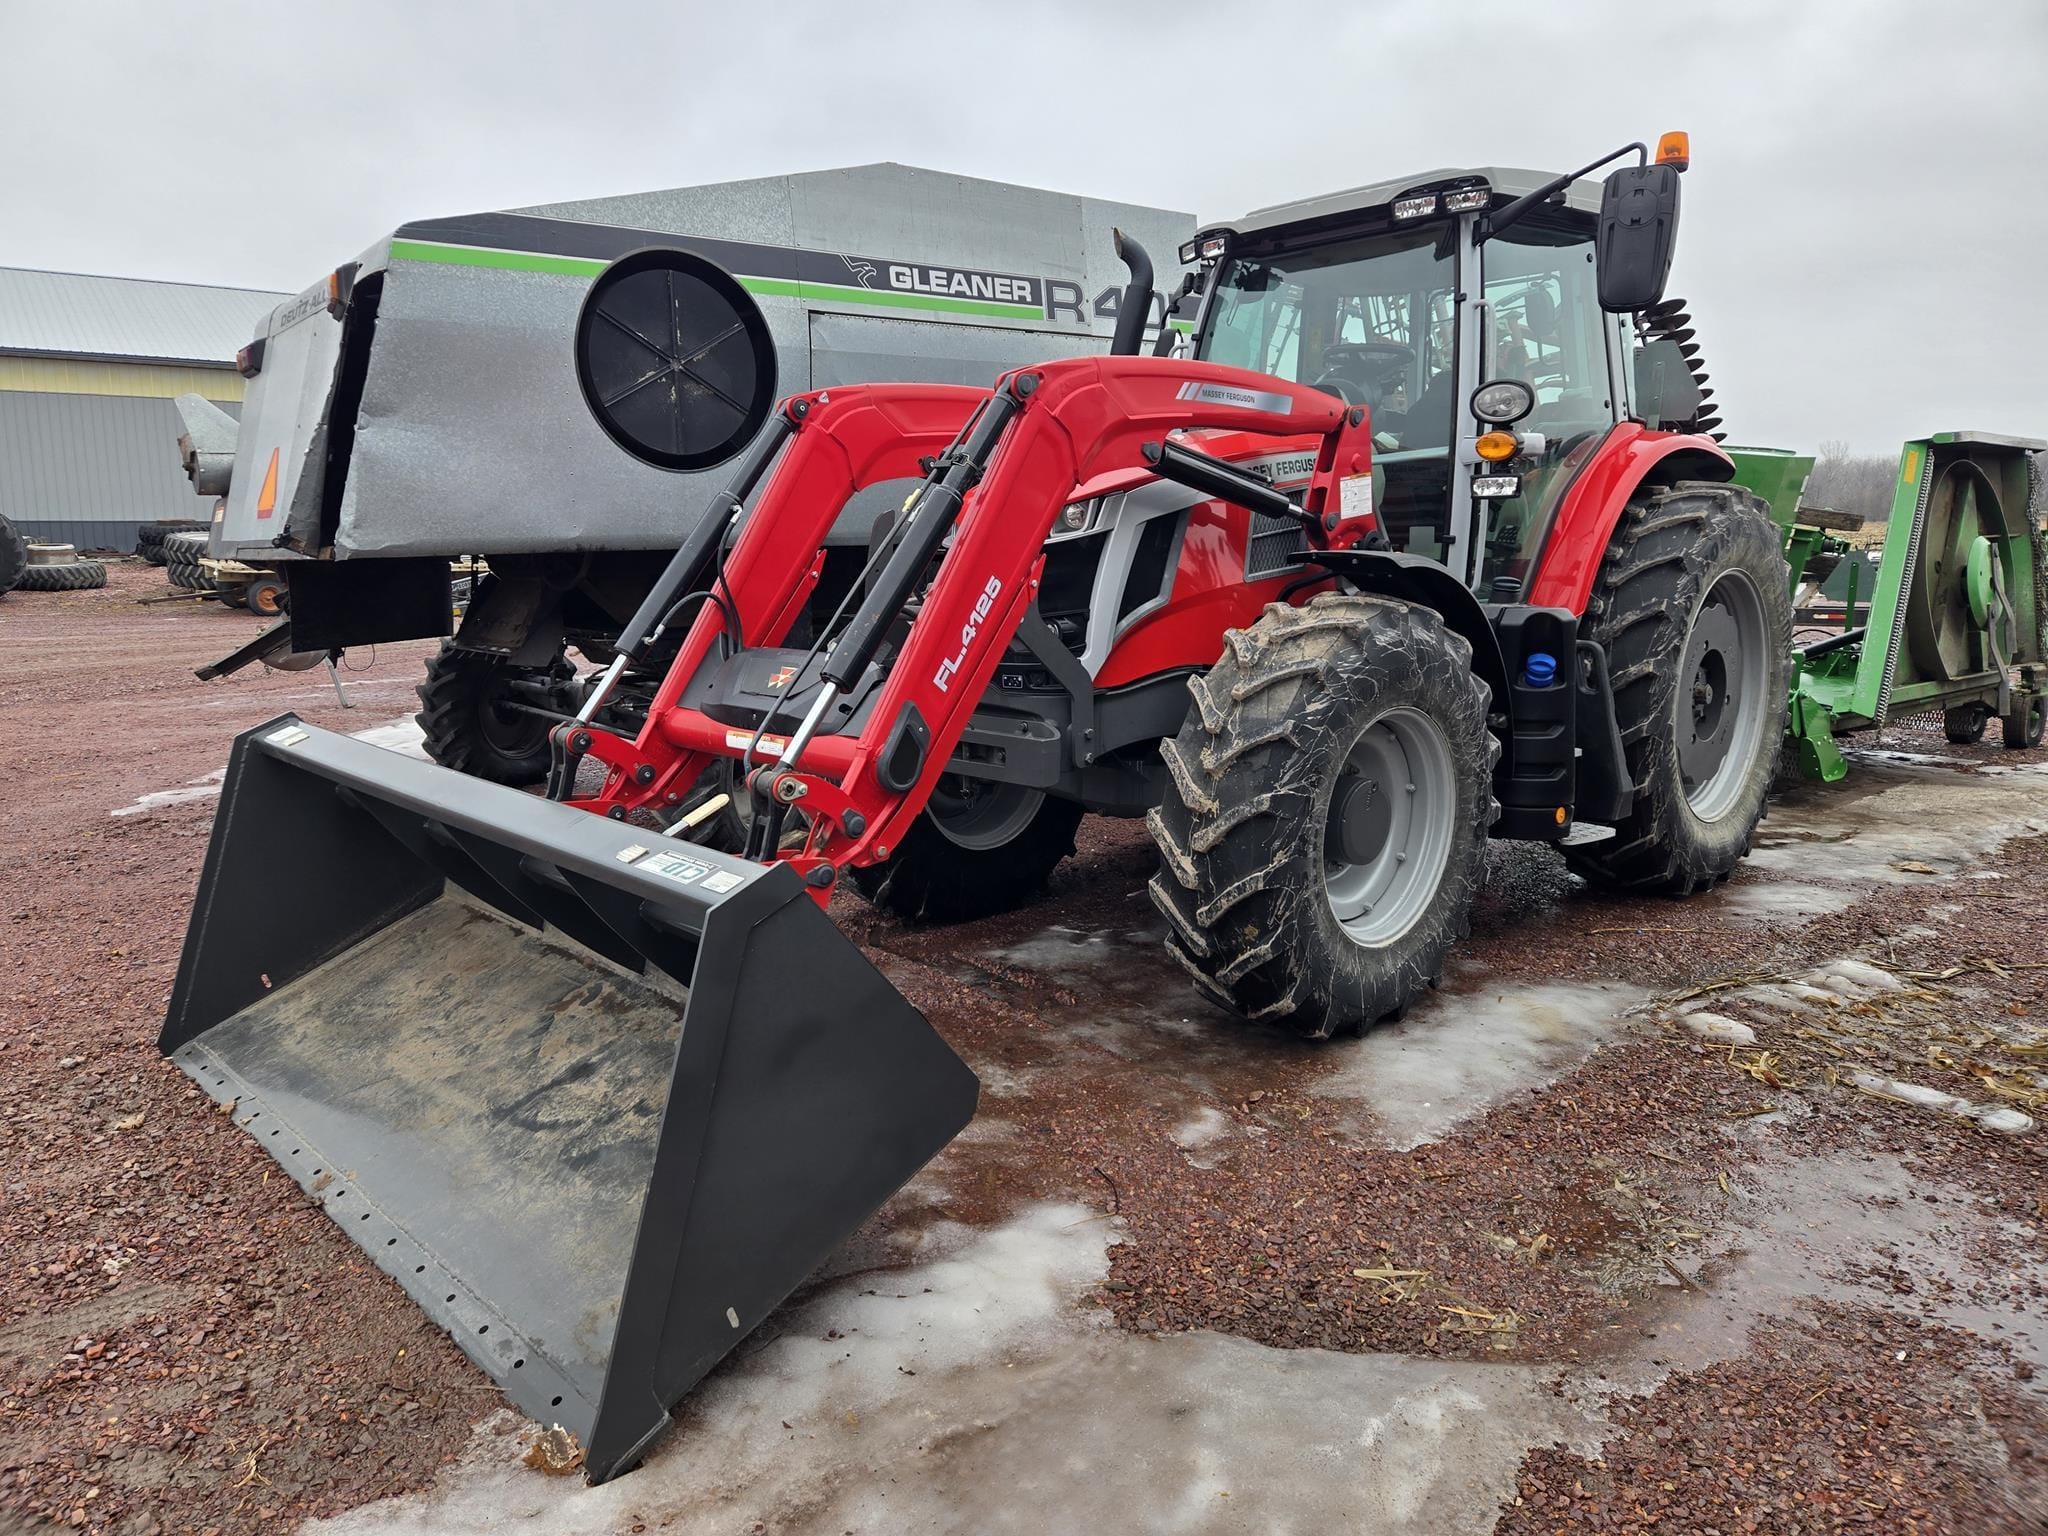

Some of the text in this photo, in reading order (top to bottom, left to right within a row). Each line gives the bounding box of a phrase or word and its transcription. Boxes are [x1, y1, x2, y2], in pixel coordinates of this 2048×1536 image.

[889, 265, 1032, 302] GLEANER
[1202, 389, 1256, 403] MASSEY FERGUSON
[933, 575, 1002, 693] FL.4125
